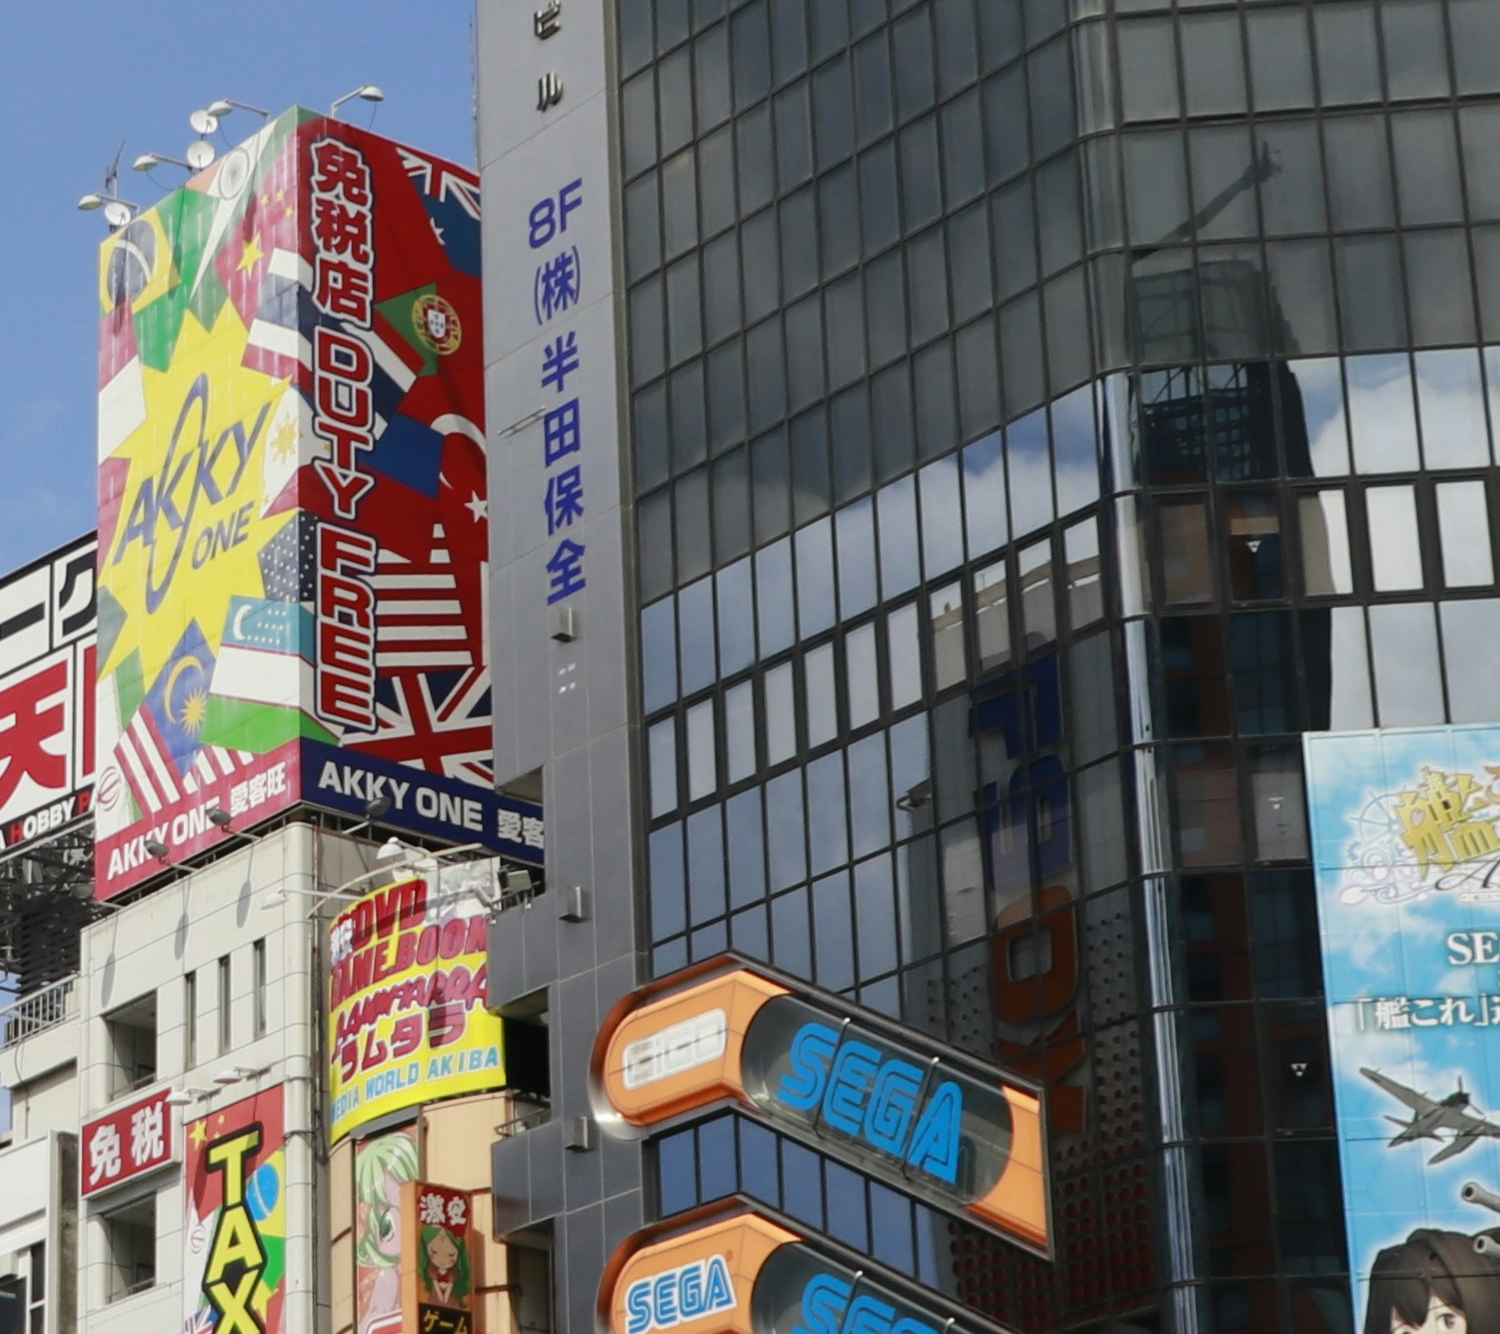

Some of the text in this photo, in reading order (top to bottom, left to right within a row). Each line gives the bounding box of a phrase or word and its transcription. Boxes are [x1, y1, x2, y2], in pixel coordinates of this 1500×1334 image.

[312, 141, 377, 733] 免税店 DUTY FREE
[193, 501, 255, 570] ONE
[8, 804, 76, 849] HOBBY
[317, 761, 485, 833] AKKY ONE
[106, 827, 173, 883] AKKY
[352, 879, 427, 947] DVD
[366, 1062, 420, 1100] WORLD
[427, 1047, 499, 1079] AKIBA
[779, 1022, 961, 1184] SEGA
[89, 1101, 164, 1185] 免税
